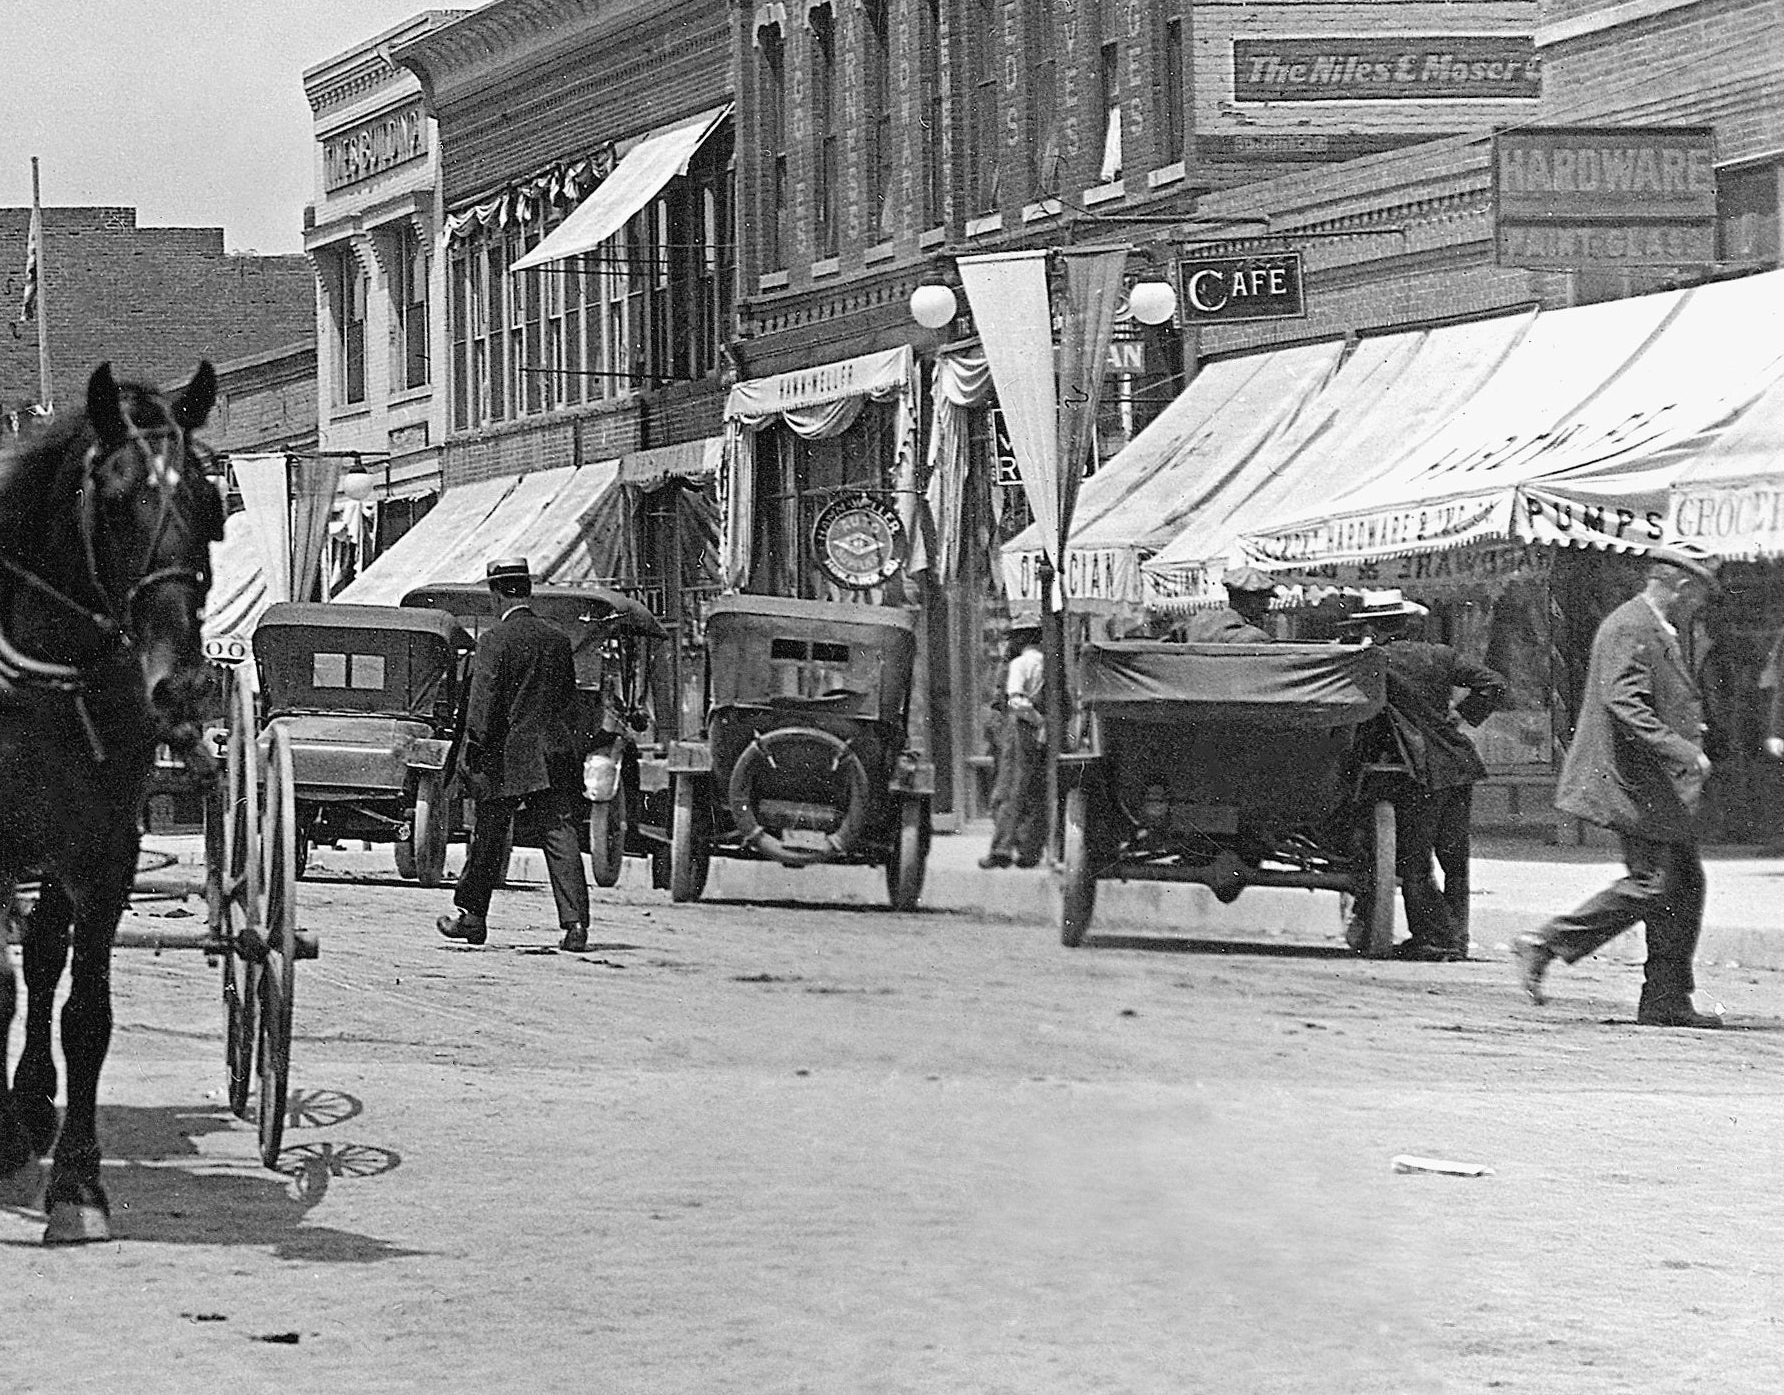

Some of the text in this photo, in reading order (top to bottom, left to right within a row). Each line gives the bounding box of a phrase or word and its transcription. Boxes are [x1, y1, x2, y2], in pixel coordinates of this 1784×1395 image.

[1246, 54, 1306, 83] The
[1308, 54, 1392, 84] Niles
[1421, 56, 1522, 82] Moser
[1498, 149, 1714, 191] HARDWARE
[1187, 268, 1288, 313] CAFE
[1526, 497, 1664, 540] PUMPS
[1021, 552, 1115, 598] OPCIAN
